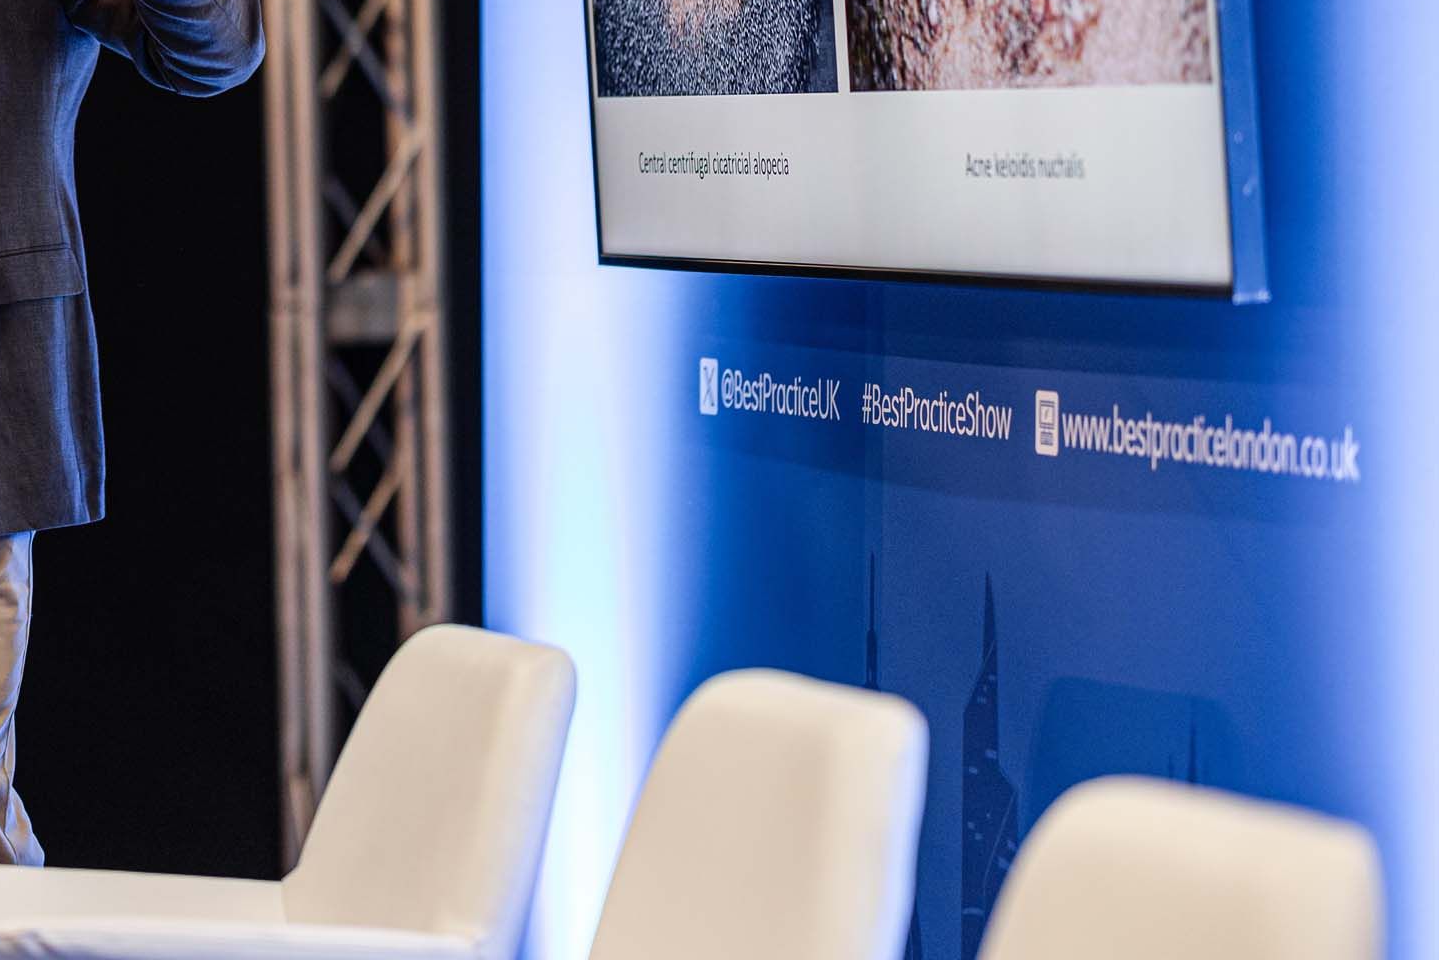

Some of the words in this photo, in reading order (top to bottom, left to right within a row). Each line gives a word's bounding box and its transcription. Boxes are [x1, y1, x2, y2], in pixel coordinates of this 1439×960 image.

[638, 151, 666, 174] Central
[668, 151, 711, 180] centrifugal
[712, 151, 751, 175] cicatricial
[753, 151, 790, 181] alopecia
[965, 152, 992, 177] Acne
[721, 368, 840, 421] @BestPracticeUK
[862, 382, 1012, 441] #BestPracticeShow
[1062, 403, 1360, 482] www.bestpracticelondon.co.uk
